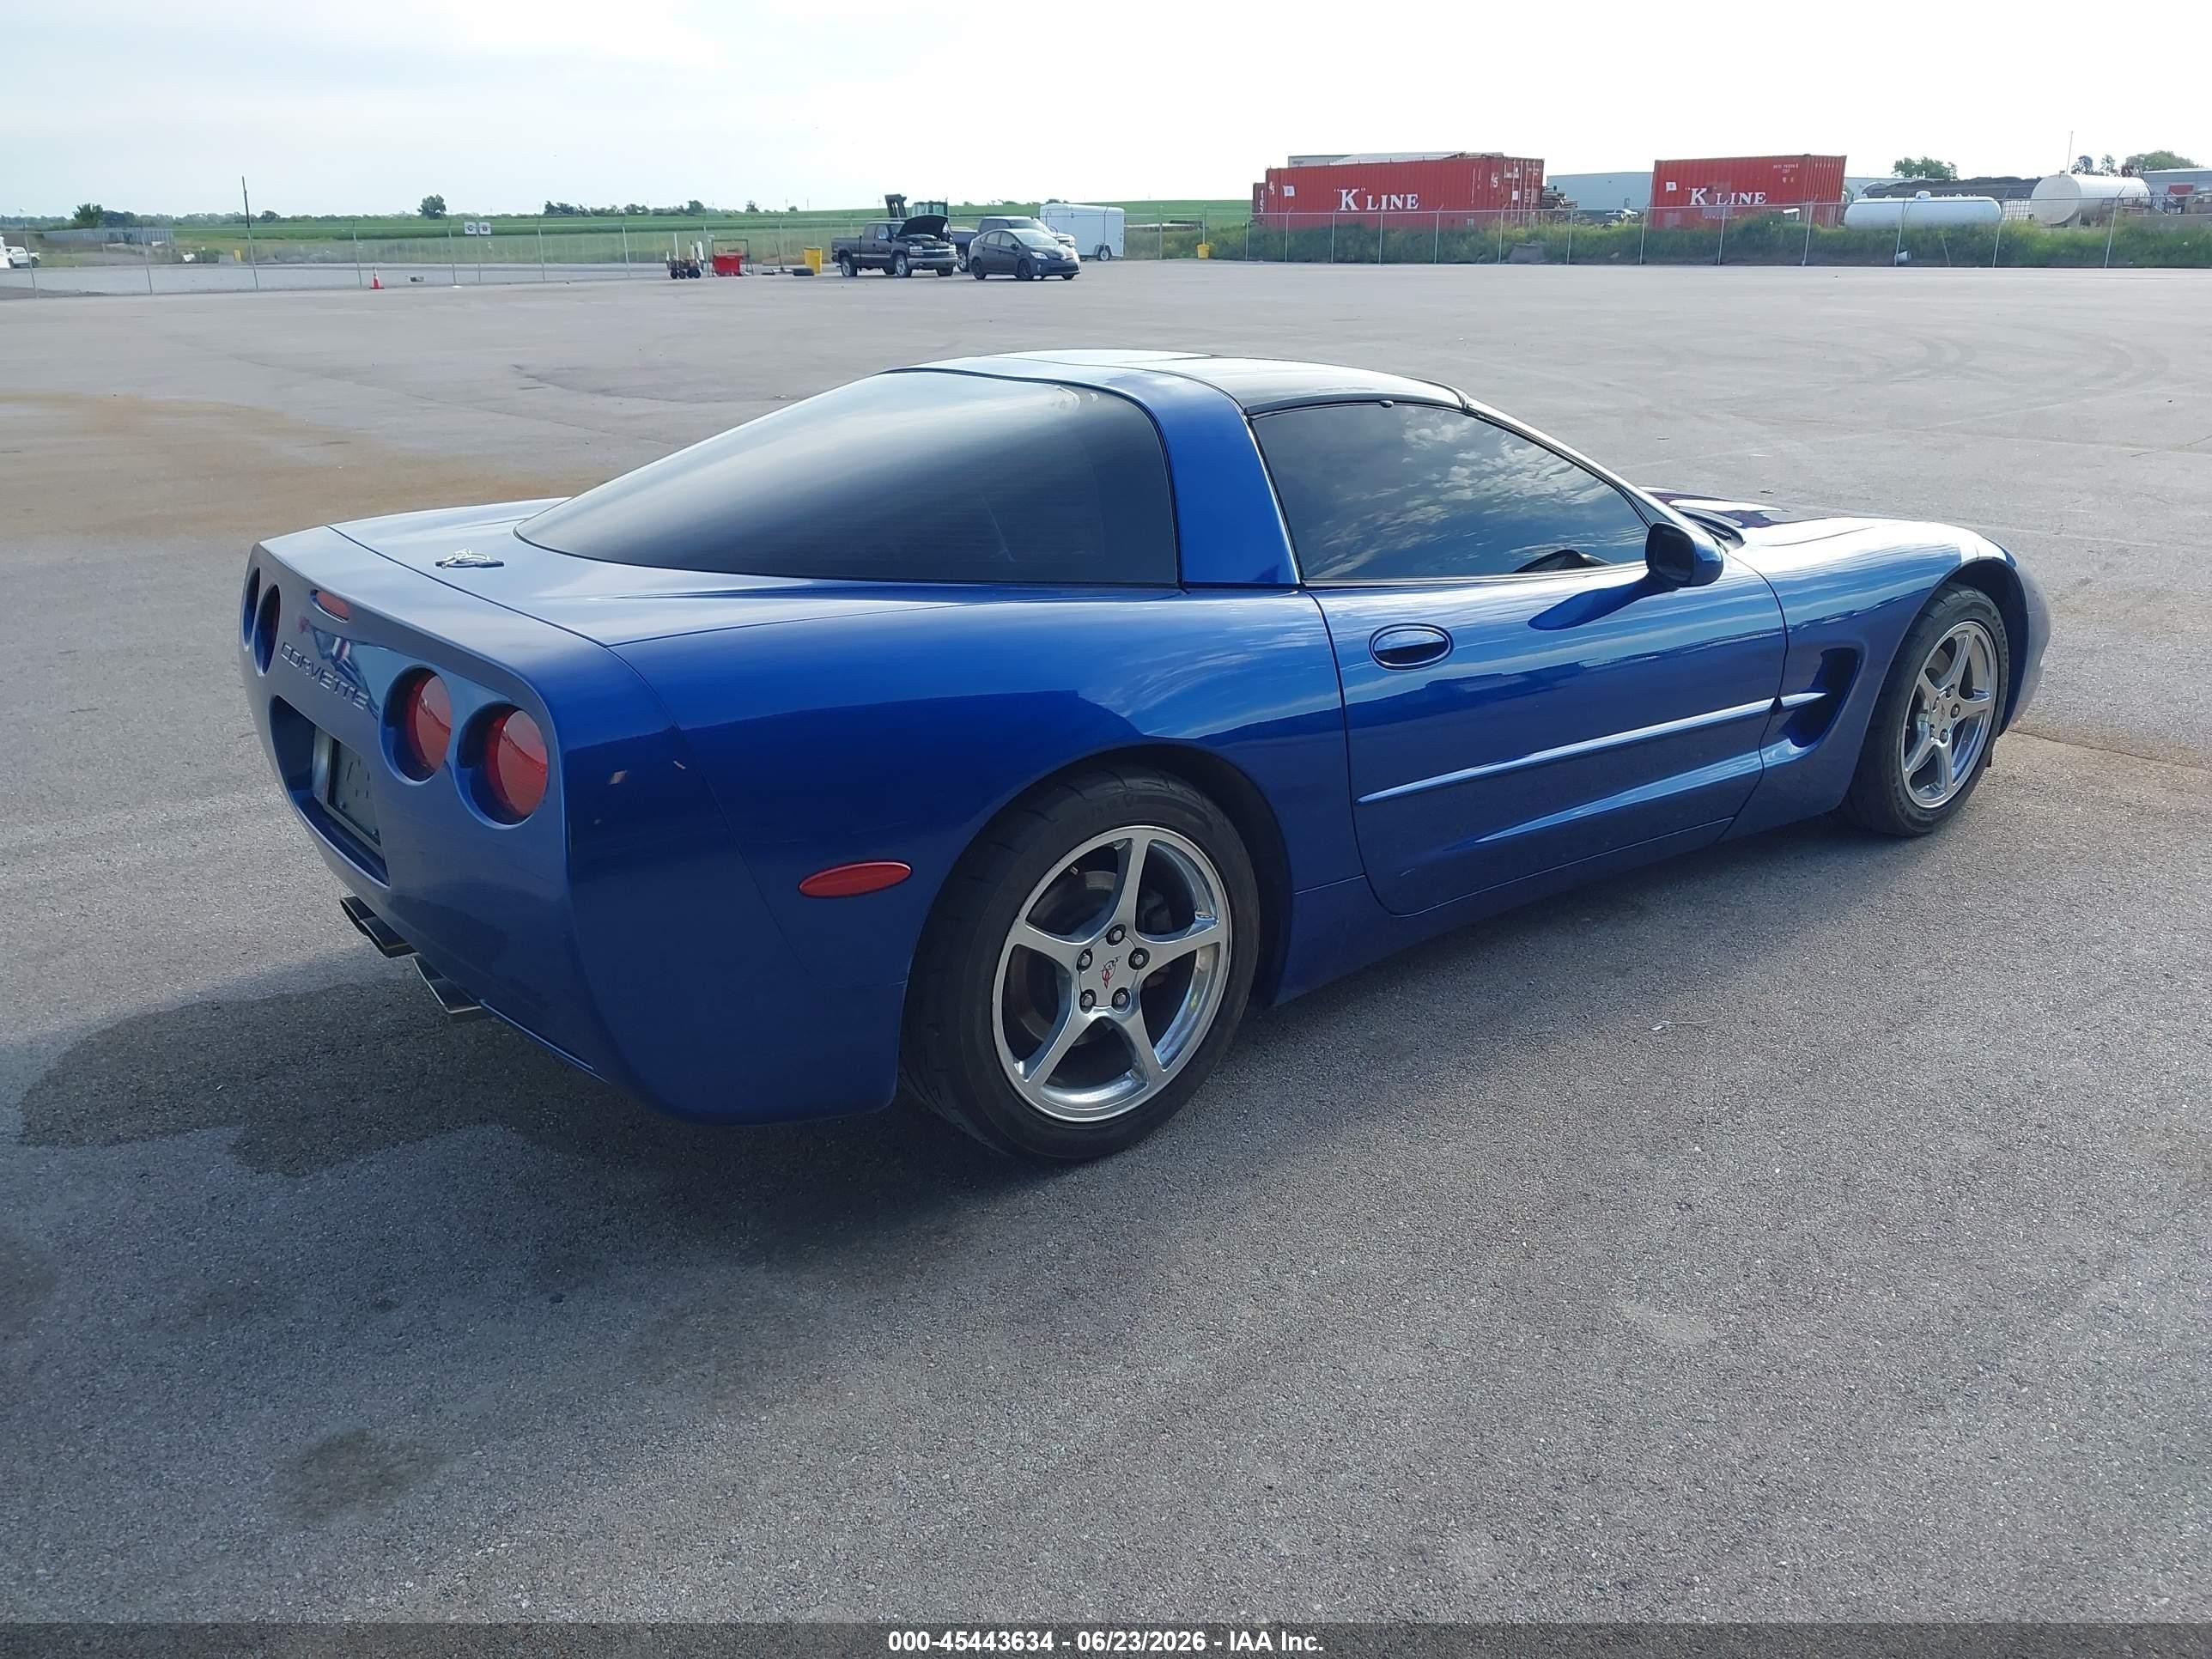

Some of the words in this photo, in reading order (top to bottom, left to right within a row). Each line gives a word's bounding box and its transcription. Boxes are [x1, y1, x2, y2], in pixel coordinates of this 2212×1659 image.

[1366, 193, 1419, 210] LINE
[1716, 191, 1767, 205] LINE
[281, 641, 370, 711] CORVETTE
